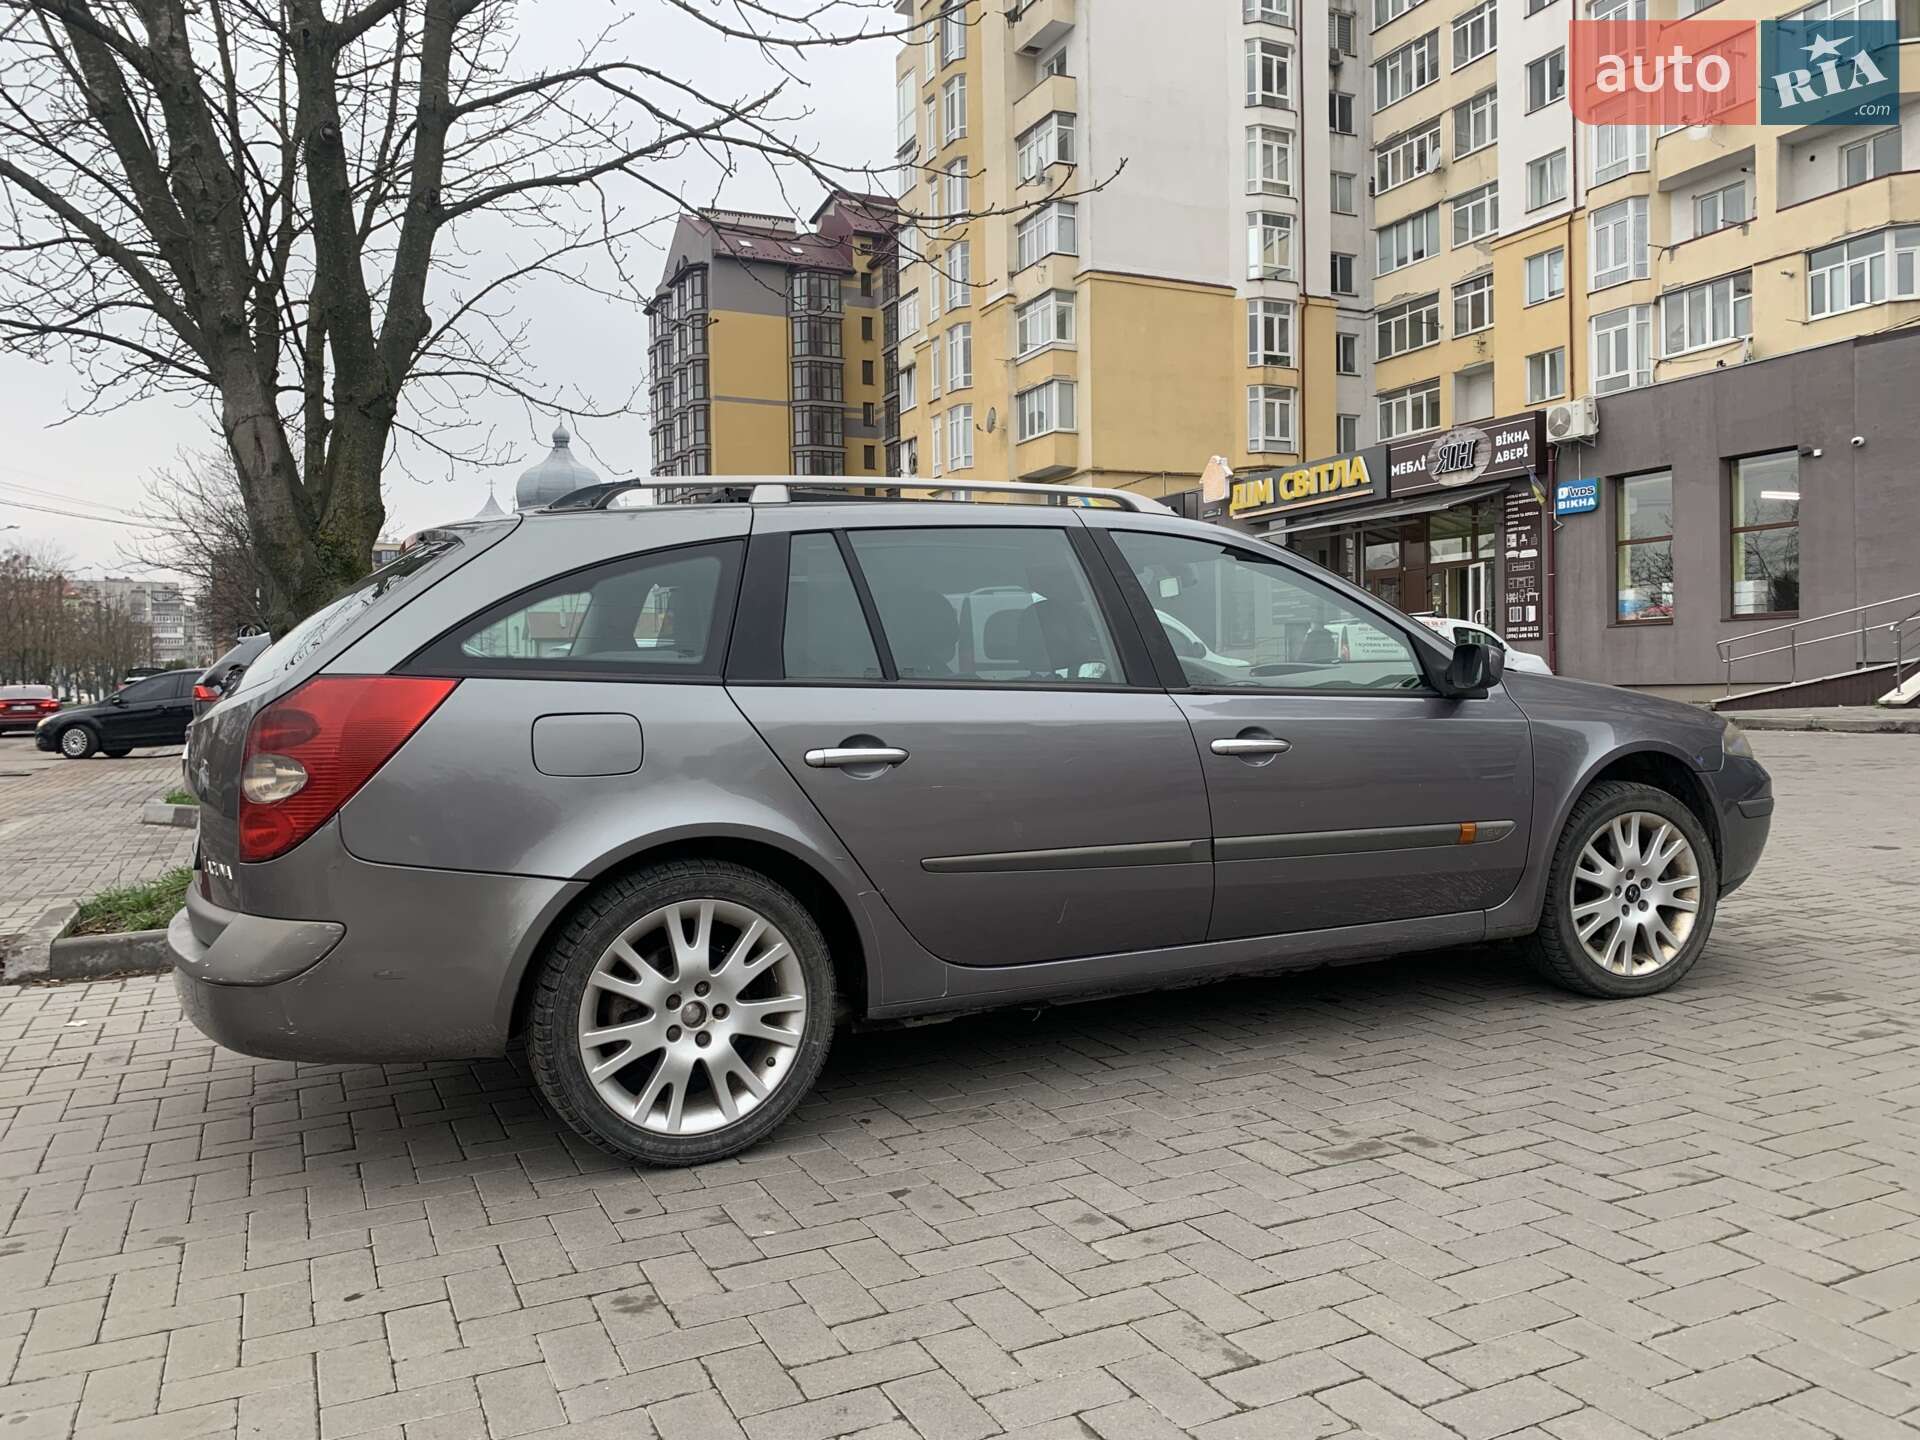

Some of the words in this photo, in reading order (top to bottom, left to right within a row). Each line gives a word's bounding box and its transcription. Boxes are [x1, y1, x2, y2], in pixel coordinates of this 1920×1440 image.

[1495, 429, 1530, 447] ВІКНА
[1433, 439, 1477, 475] ЯН
[1495, 443, 1529, 464] ДВЕРІ
[1391, 455, 1426, 476] МЕБЛІ
[1229, 477, 1275, 517] ДІМ
[1279, 455, 1371, 500] СВІТЛА
[1568, 485, 1595, 497] WDS
[1558, 497, 1596, 510] ВІКНА
